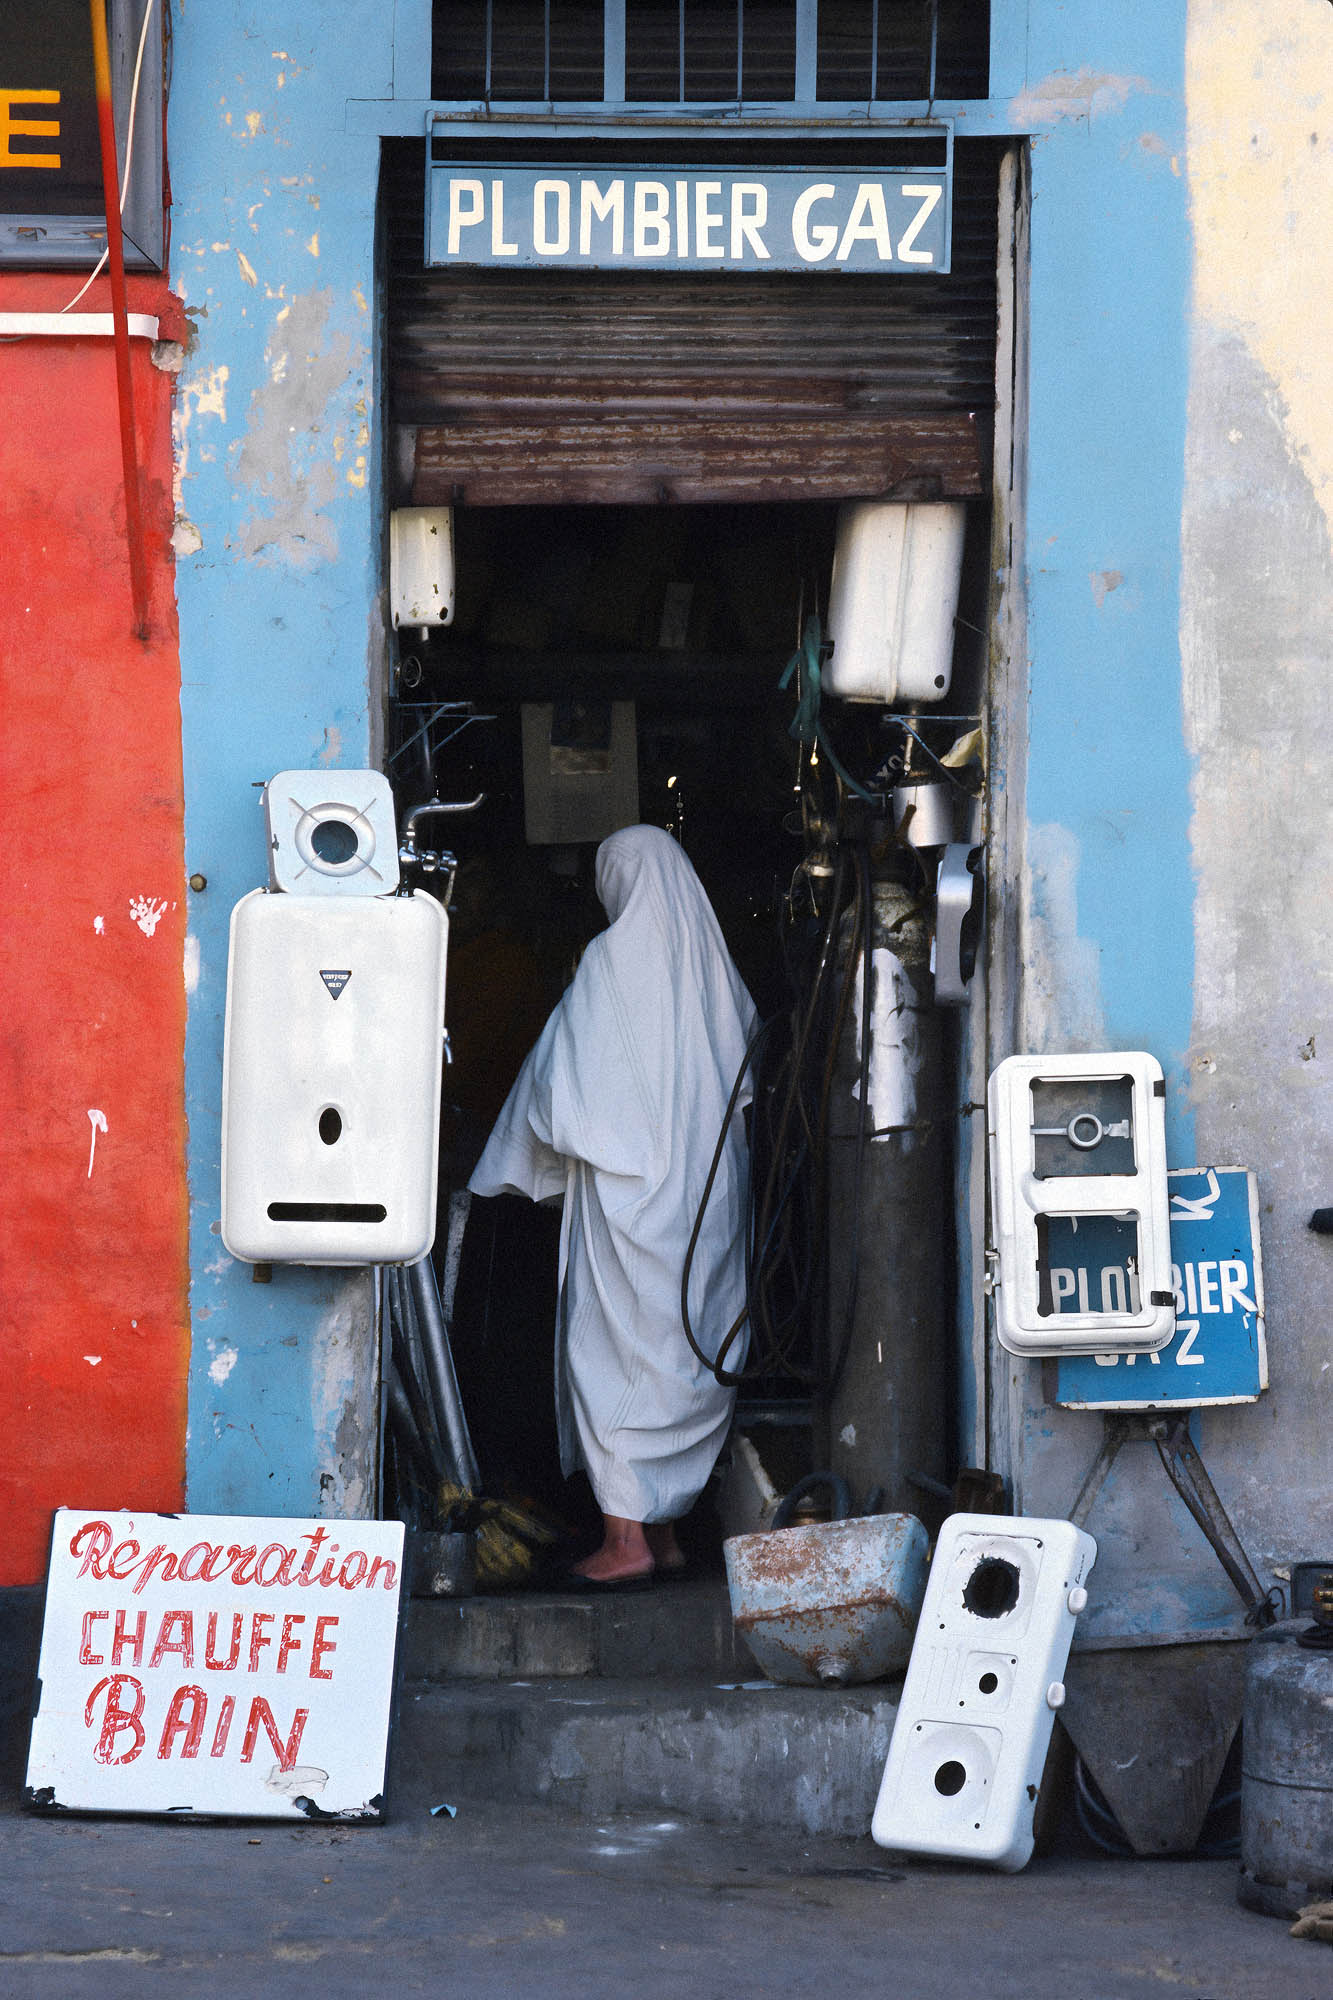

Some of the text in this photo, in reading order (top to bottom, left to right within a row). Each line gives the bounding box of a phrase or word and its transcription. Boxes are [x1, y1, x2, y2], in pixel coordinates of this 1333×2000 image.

[0, 88, 61, 168] E
[448, 179, 943, 264] PLOMBIER GAZ
[69, 1520, 398, 1596] Réparation
[78, 1609, 340, 1680] CHAUFFE
[83, 1673, 310, 1773] BAIN
